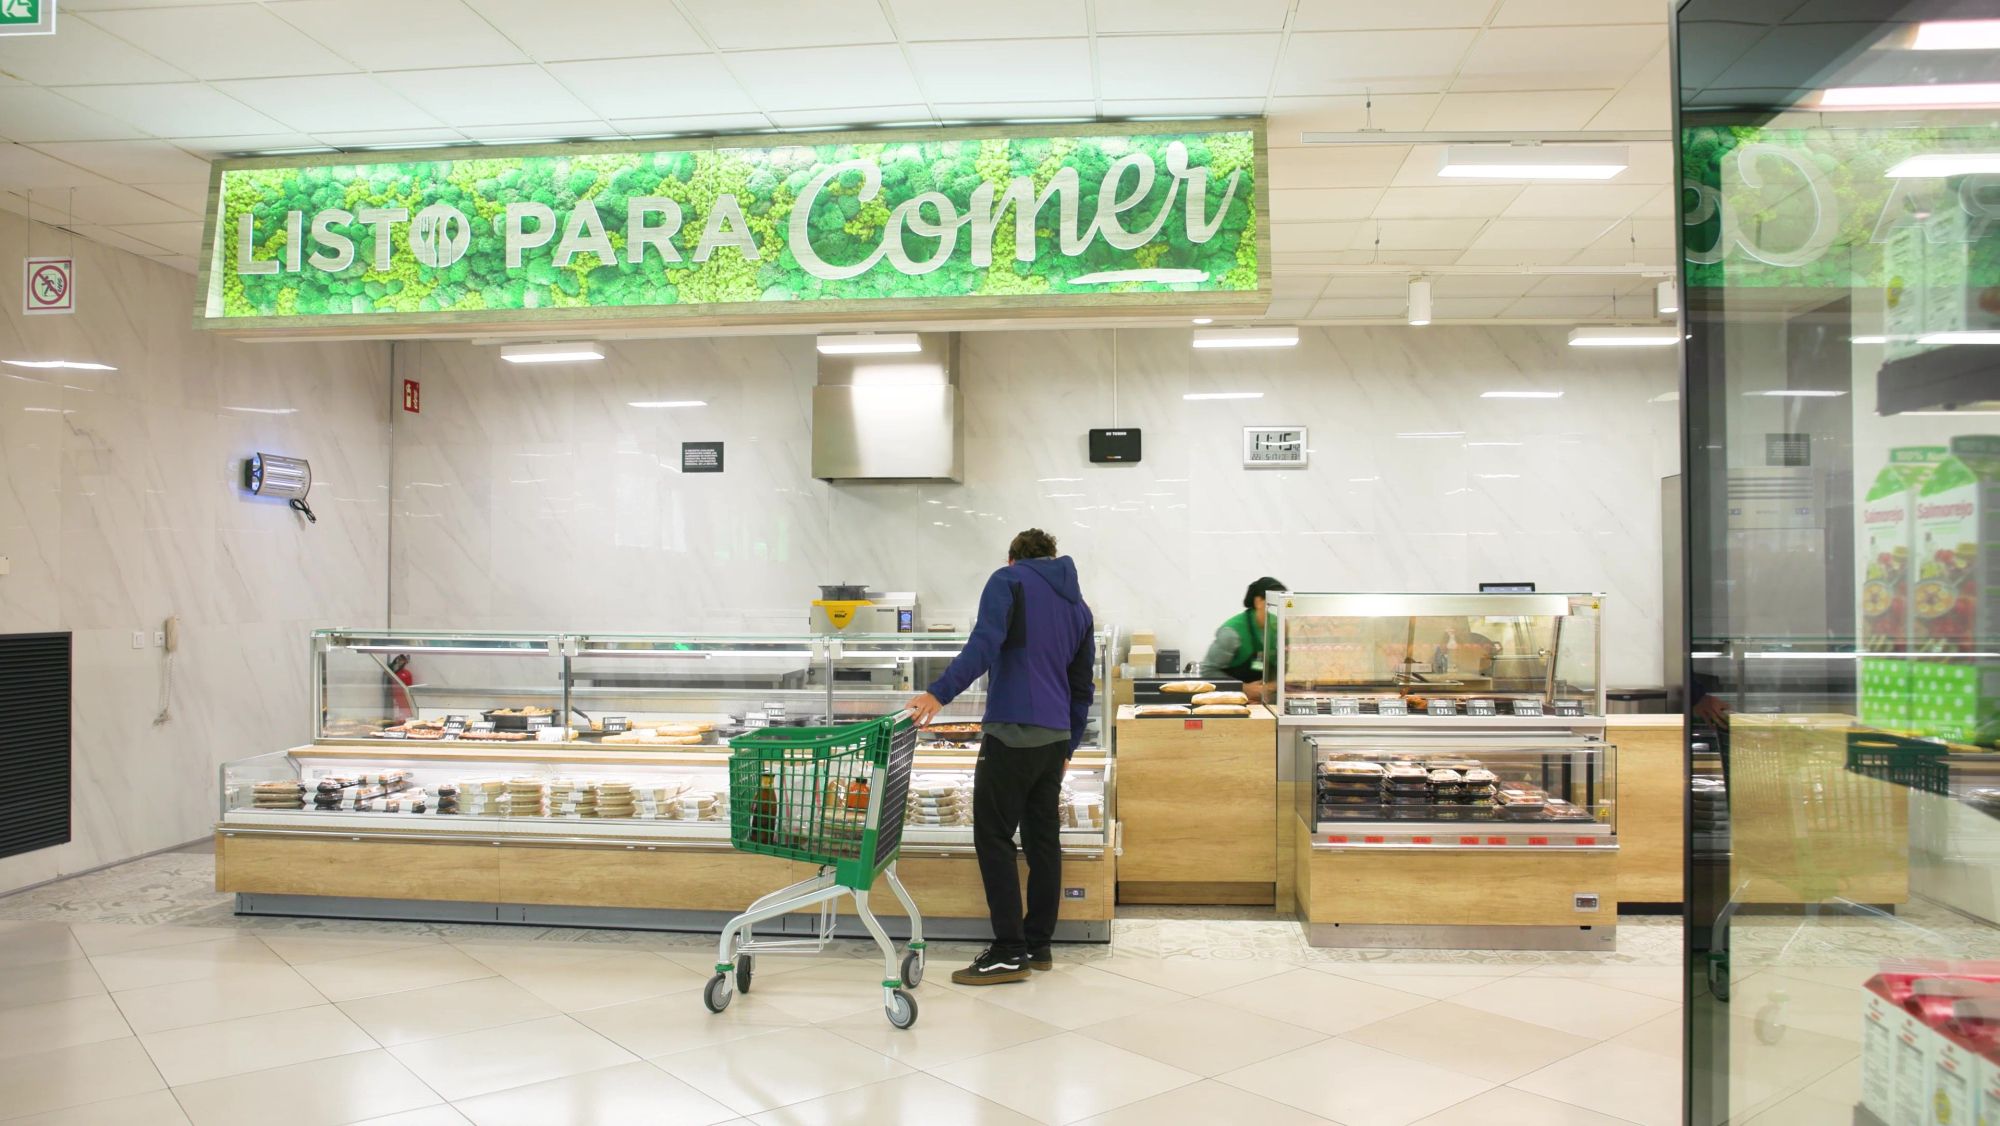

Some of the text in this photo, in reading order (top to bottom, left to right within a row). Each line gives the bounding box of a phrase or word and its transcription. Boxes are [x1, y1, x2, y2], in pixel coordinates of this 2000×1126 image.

[237, 140, 1242, 281] LISTO PARA Comer
